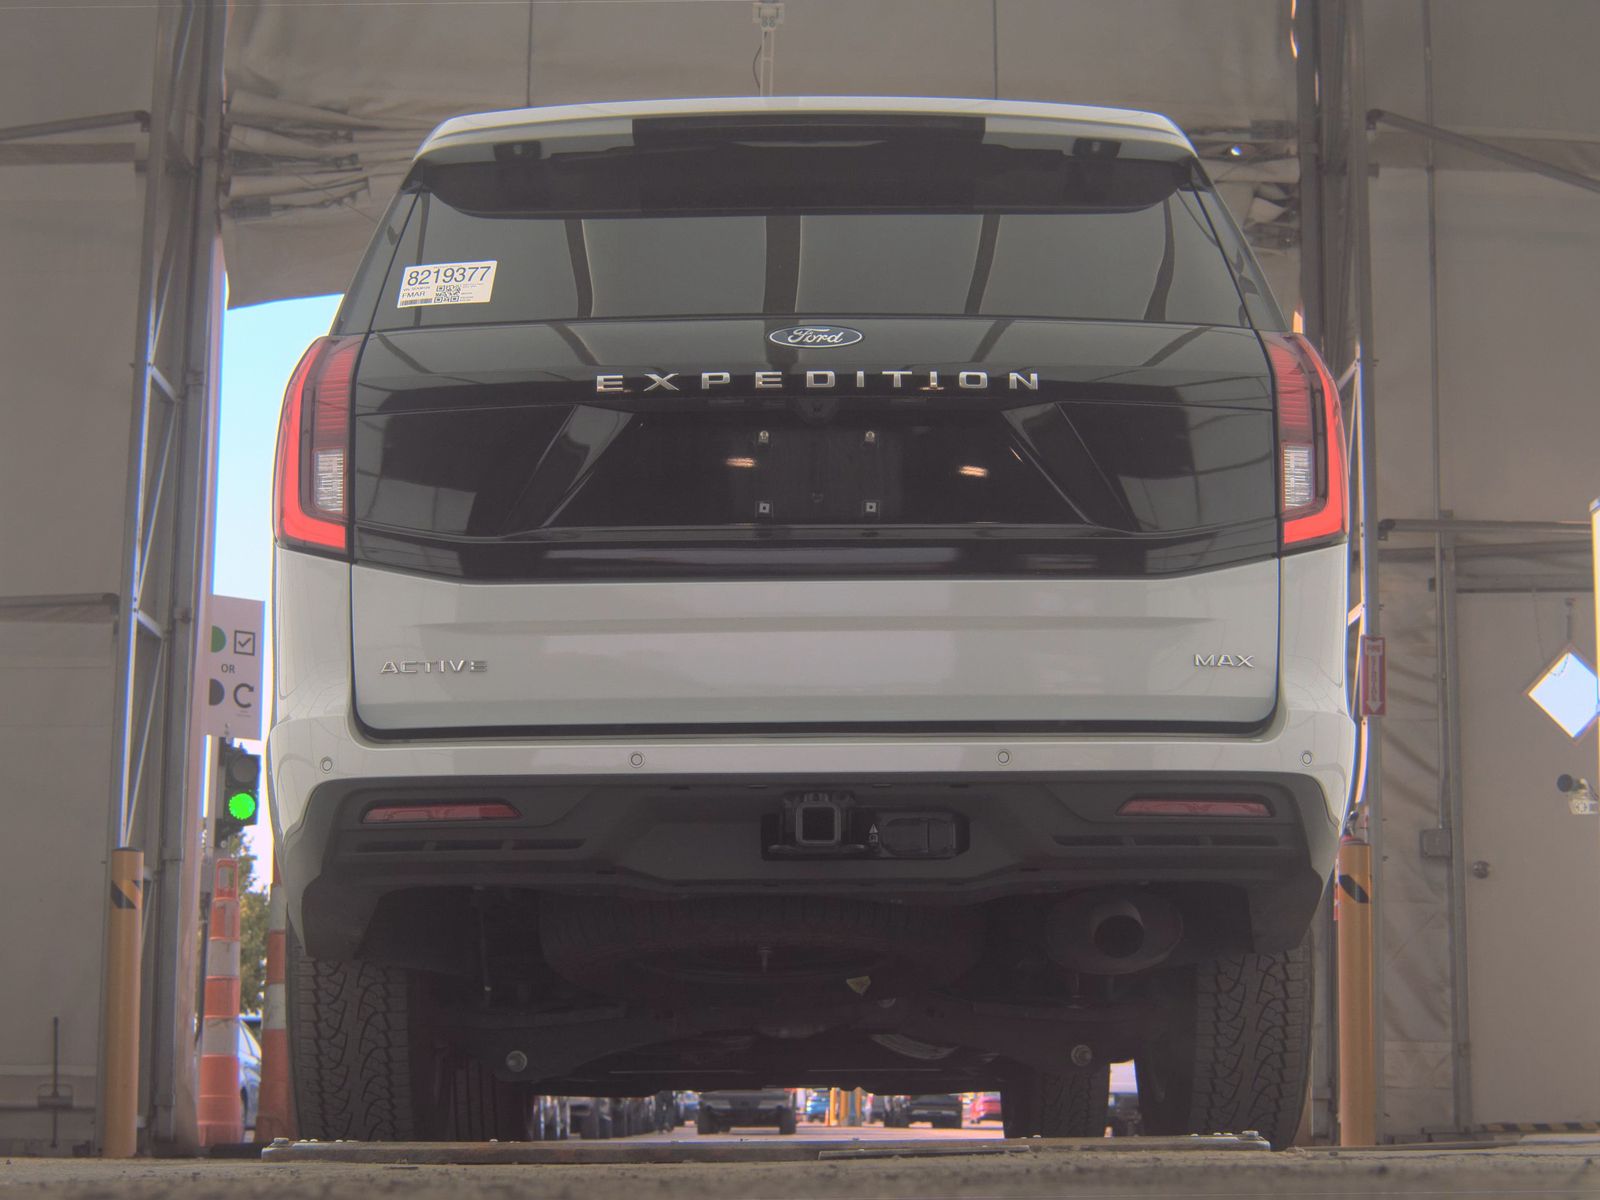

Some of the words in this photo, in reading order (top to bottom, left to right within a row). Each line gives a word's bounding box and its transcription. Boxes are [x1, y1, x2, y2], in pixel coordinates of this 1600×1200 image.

[407, 266, 492, 286] 8219377
[787, 328, 844, 343] Ford
[596, 370, 1039, 392] EXPEDITION
[380, 659, 488, 674] ACTIVE
[1194, 654, 1255, 667] MAX
[221, 663, 236, 674] OR
